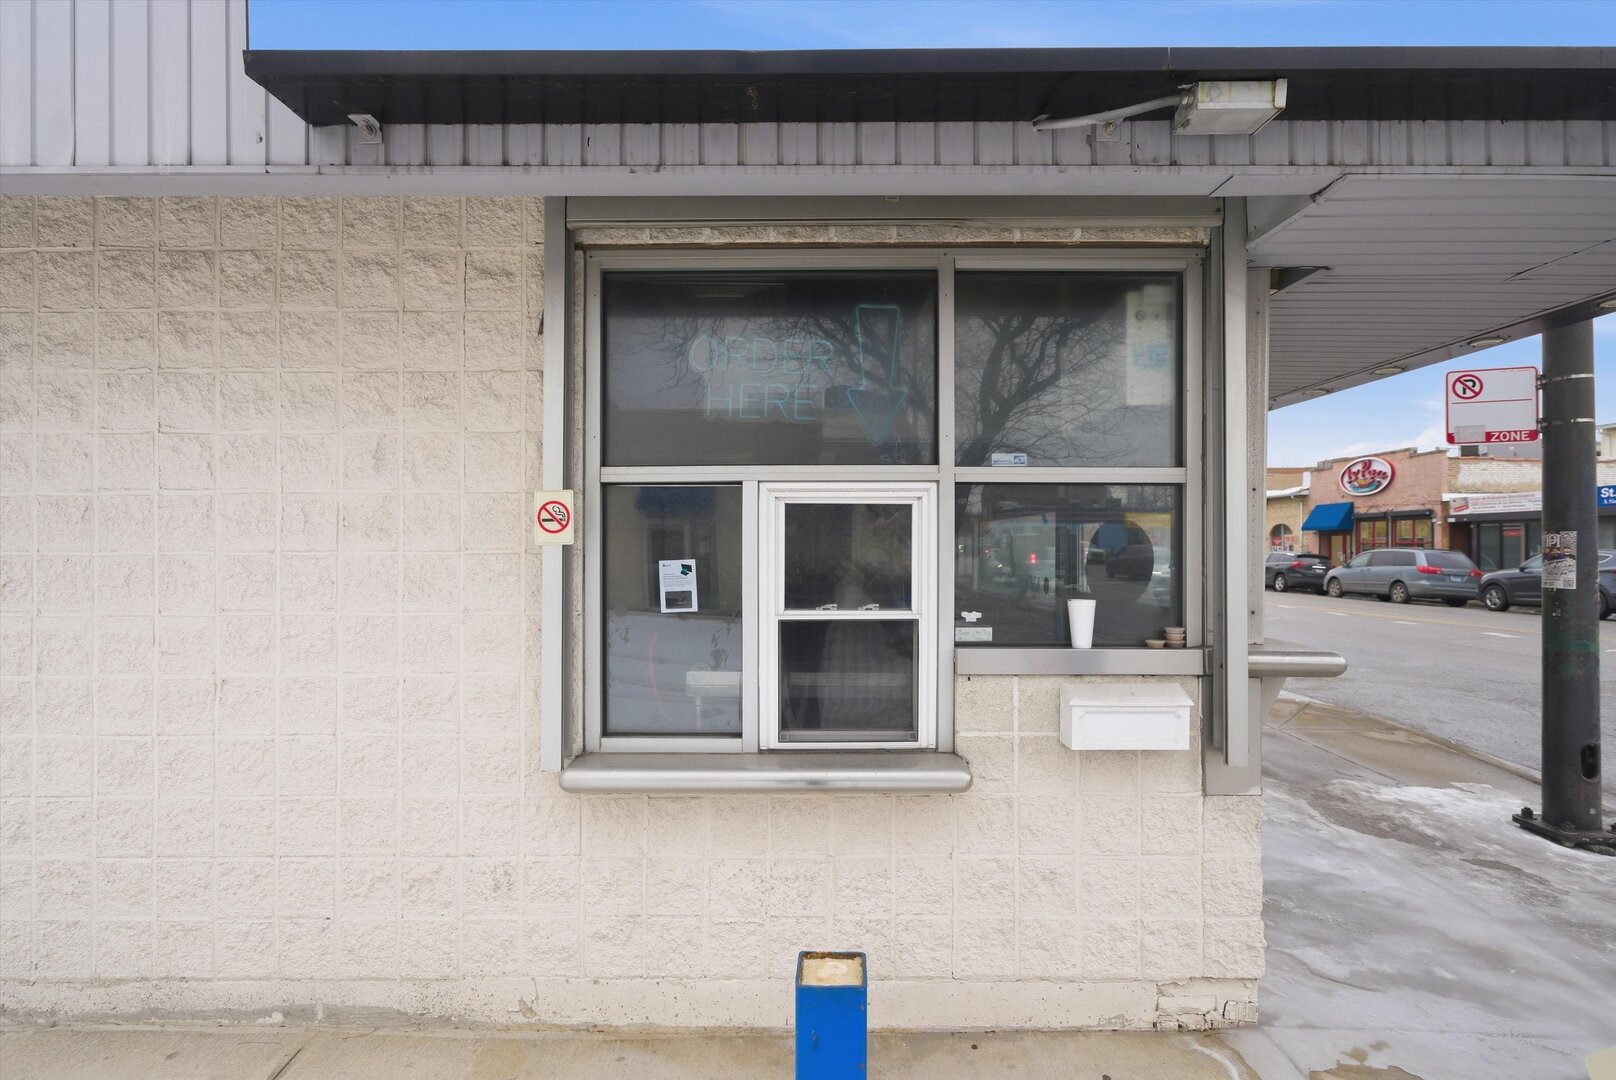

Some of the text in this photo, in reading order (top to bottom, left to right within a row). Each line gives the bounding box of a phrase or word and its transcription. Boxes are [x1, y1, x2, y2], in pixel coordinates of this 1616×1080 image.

[688, 335, 836, 376] ORDER
[705, 383, 817, 421] HERE
[1490, 430, 1530, 442] ZONE
